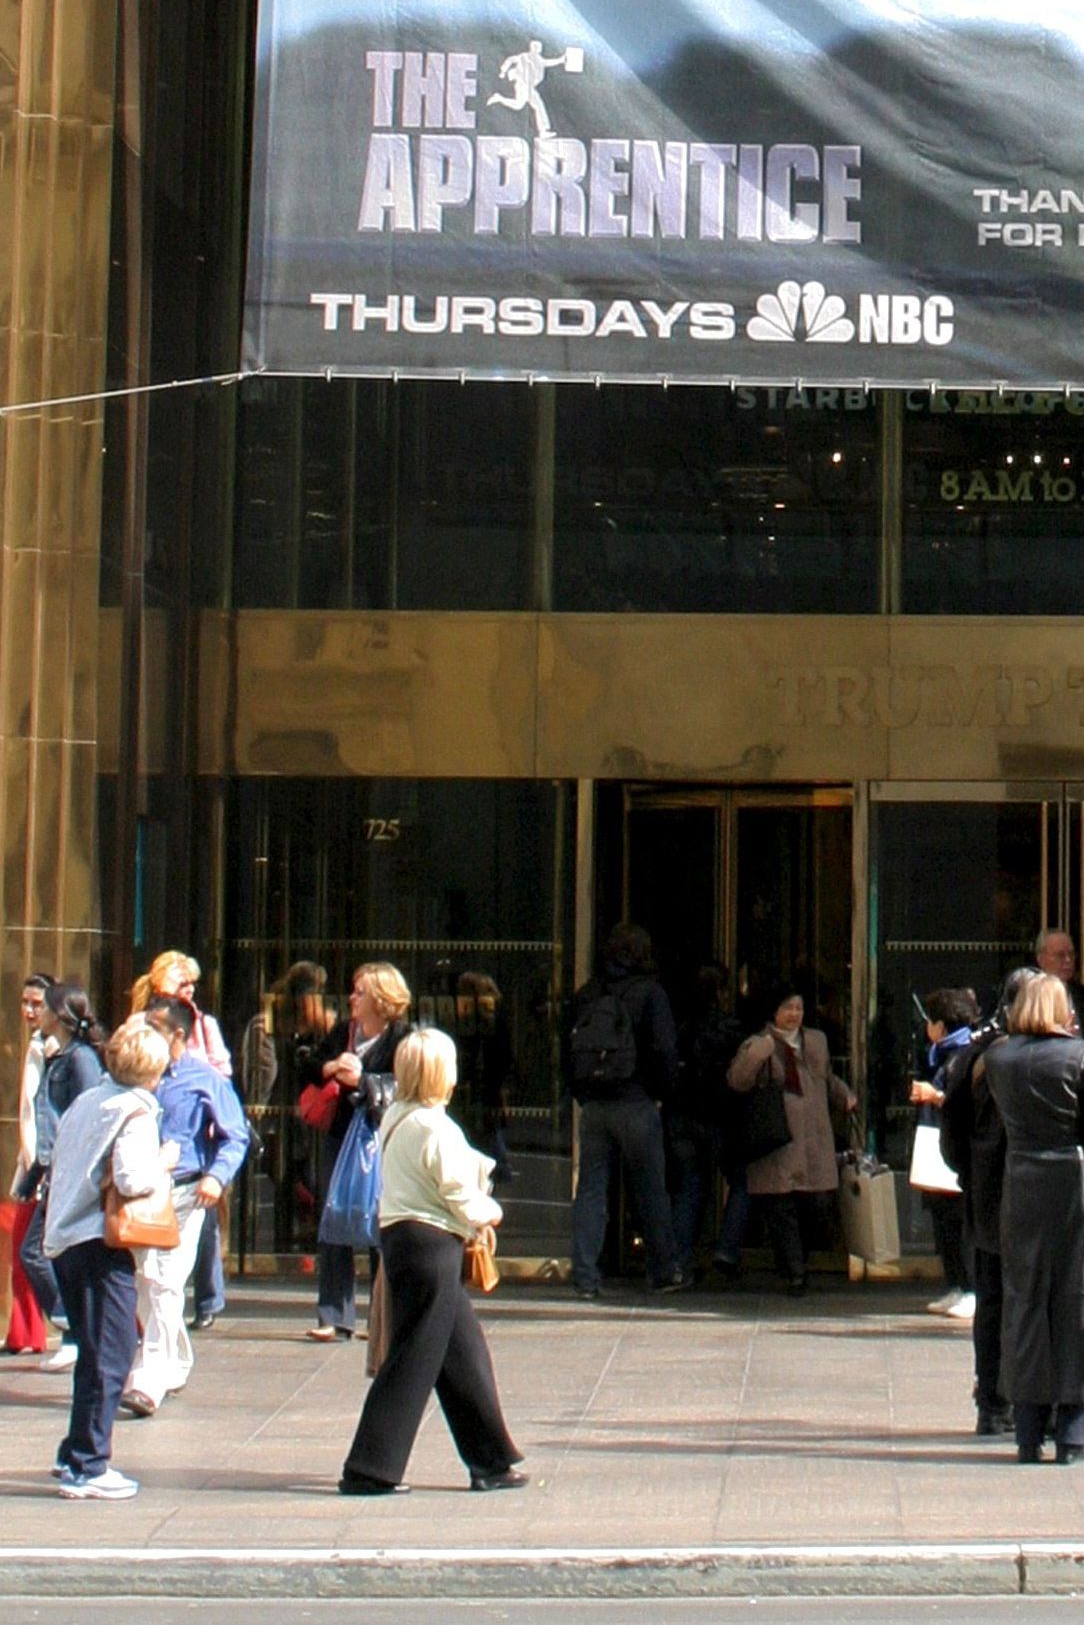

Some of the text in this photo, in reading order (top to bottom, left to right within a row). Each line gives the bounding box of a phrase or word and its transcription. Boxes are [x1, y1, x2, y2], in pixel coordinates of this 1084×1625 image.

[364, 50, 480, 129] THE
[356, 132, 864, 245] APPRENTICE
[977, 222, 1063, 247] FOR
[310, 291, 956, 346] THURSDAYS NBC
[1039, 471, 1077, 502] to
[772, 668, 1056, 729] TRUMP
[362, 819, 400, 841] 725
